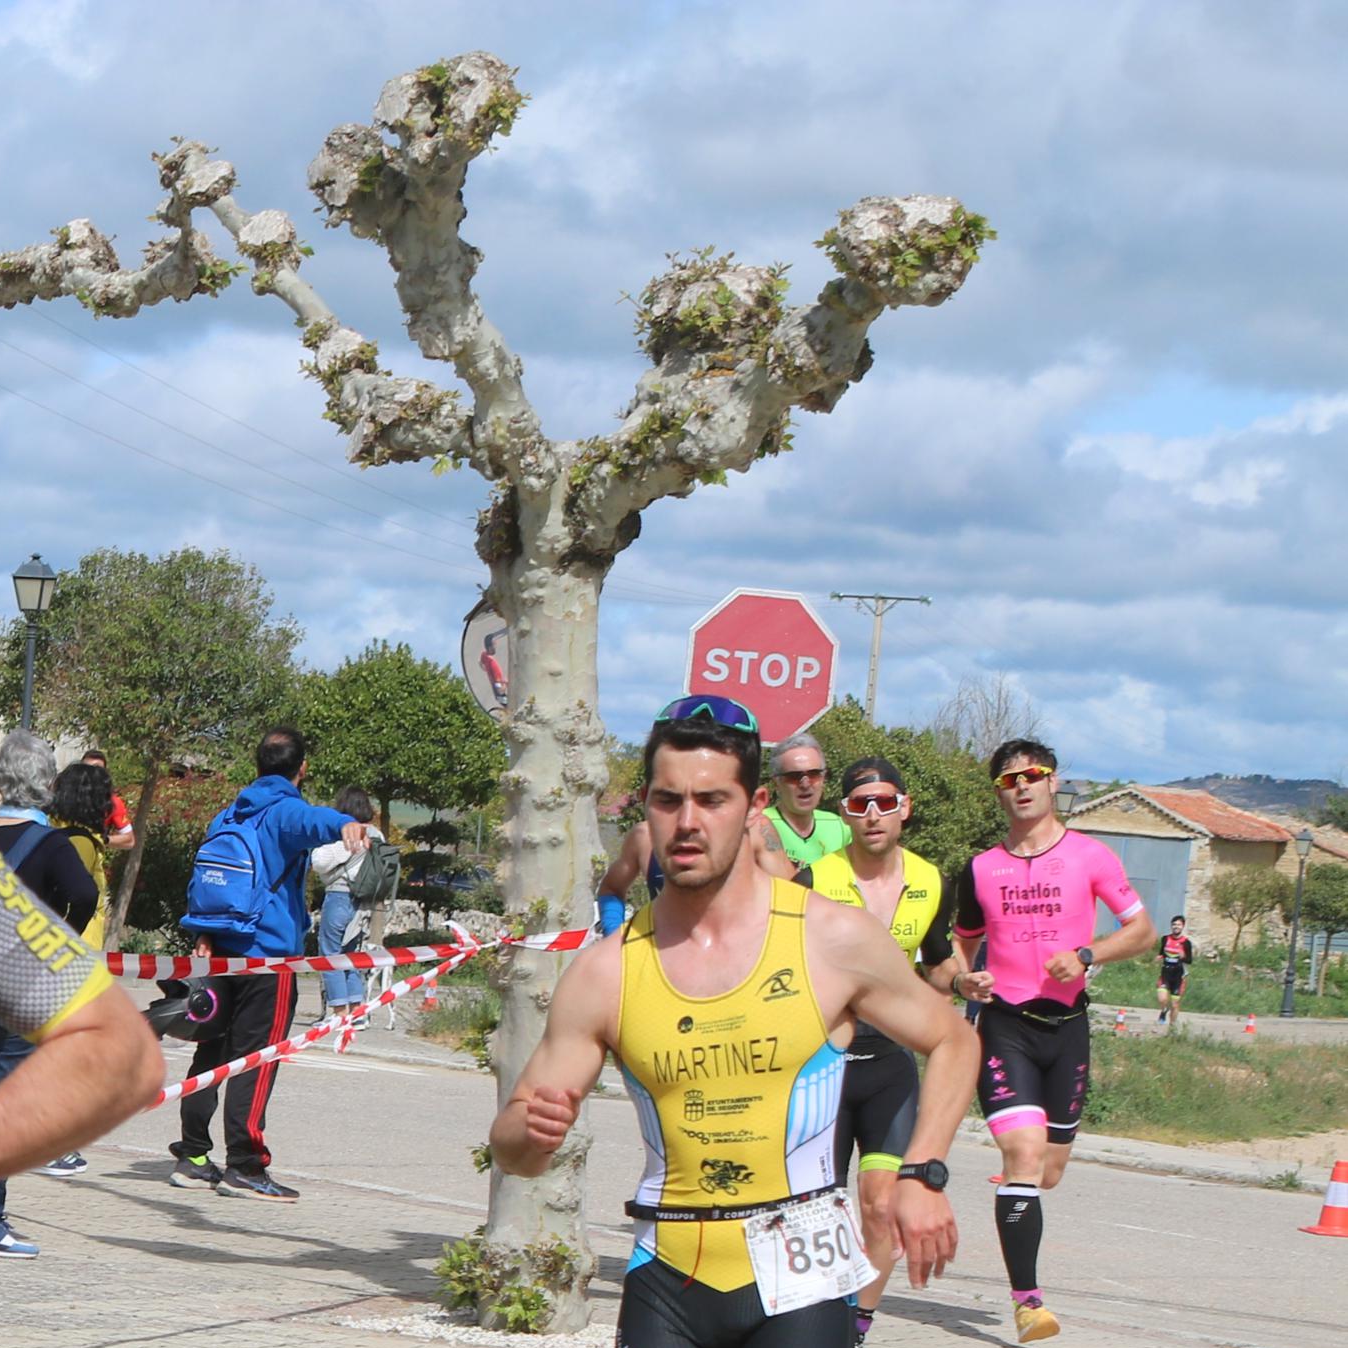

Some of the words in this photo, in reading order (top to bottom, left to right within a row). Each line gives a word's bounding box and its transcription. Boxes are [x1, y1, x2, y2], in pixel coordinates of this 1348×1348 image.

[702, 647, 821, 689] STOP
[999, 882, 1062, 901] Triatlón
[1002, 902, 1062, 917] Pisuerga
[653, 1036, 783, 1084] MARTINEZ
[786, 1223, 851, 1275] 850
